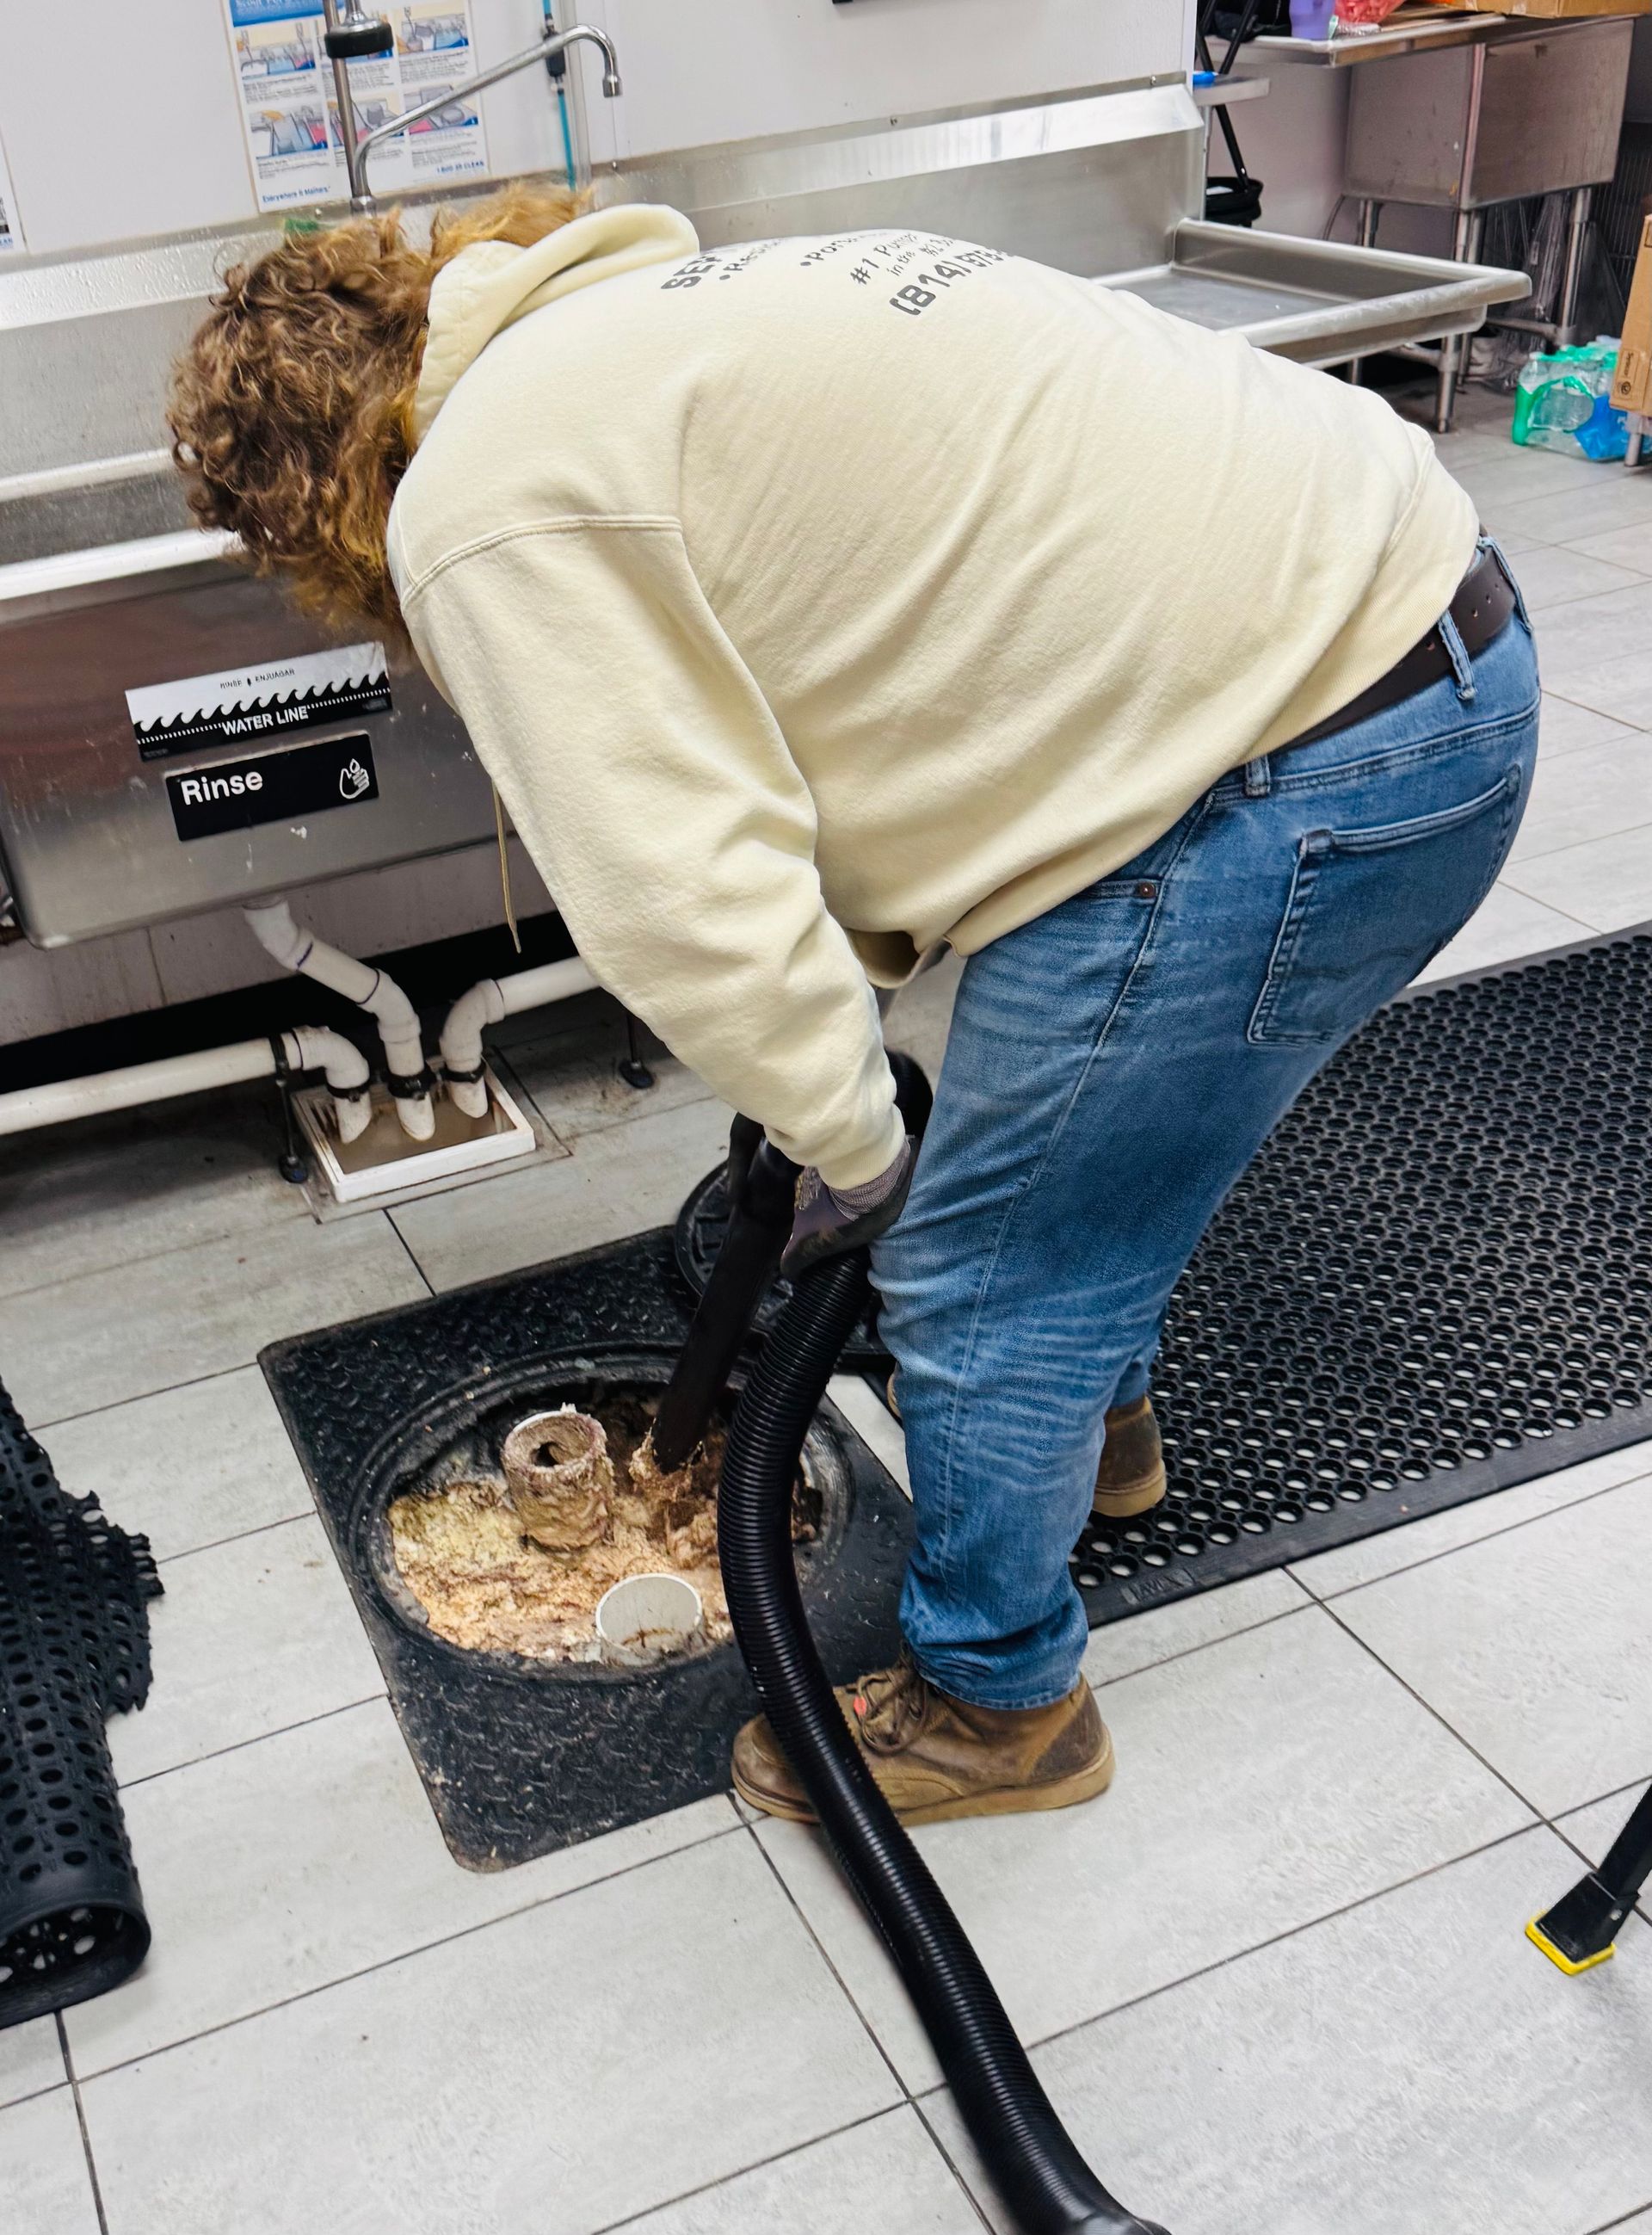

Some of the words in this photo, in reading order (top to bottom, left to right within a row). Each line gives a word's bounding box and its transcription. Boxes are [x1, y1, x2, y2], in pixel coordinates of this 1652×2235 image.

[850, 257, 879, 286] #1
[889, 259, 971, 316] (814)
[221, 713, 274, 736] WATER
[275, 705, 310, 725] LINE
[181, 770, 263, 806] Rinse
